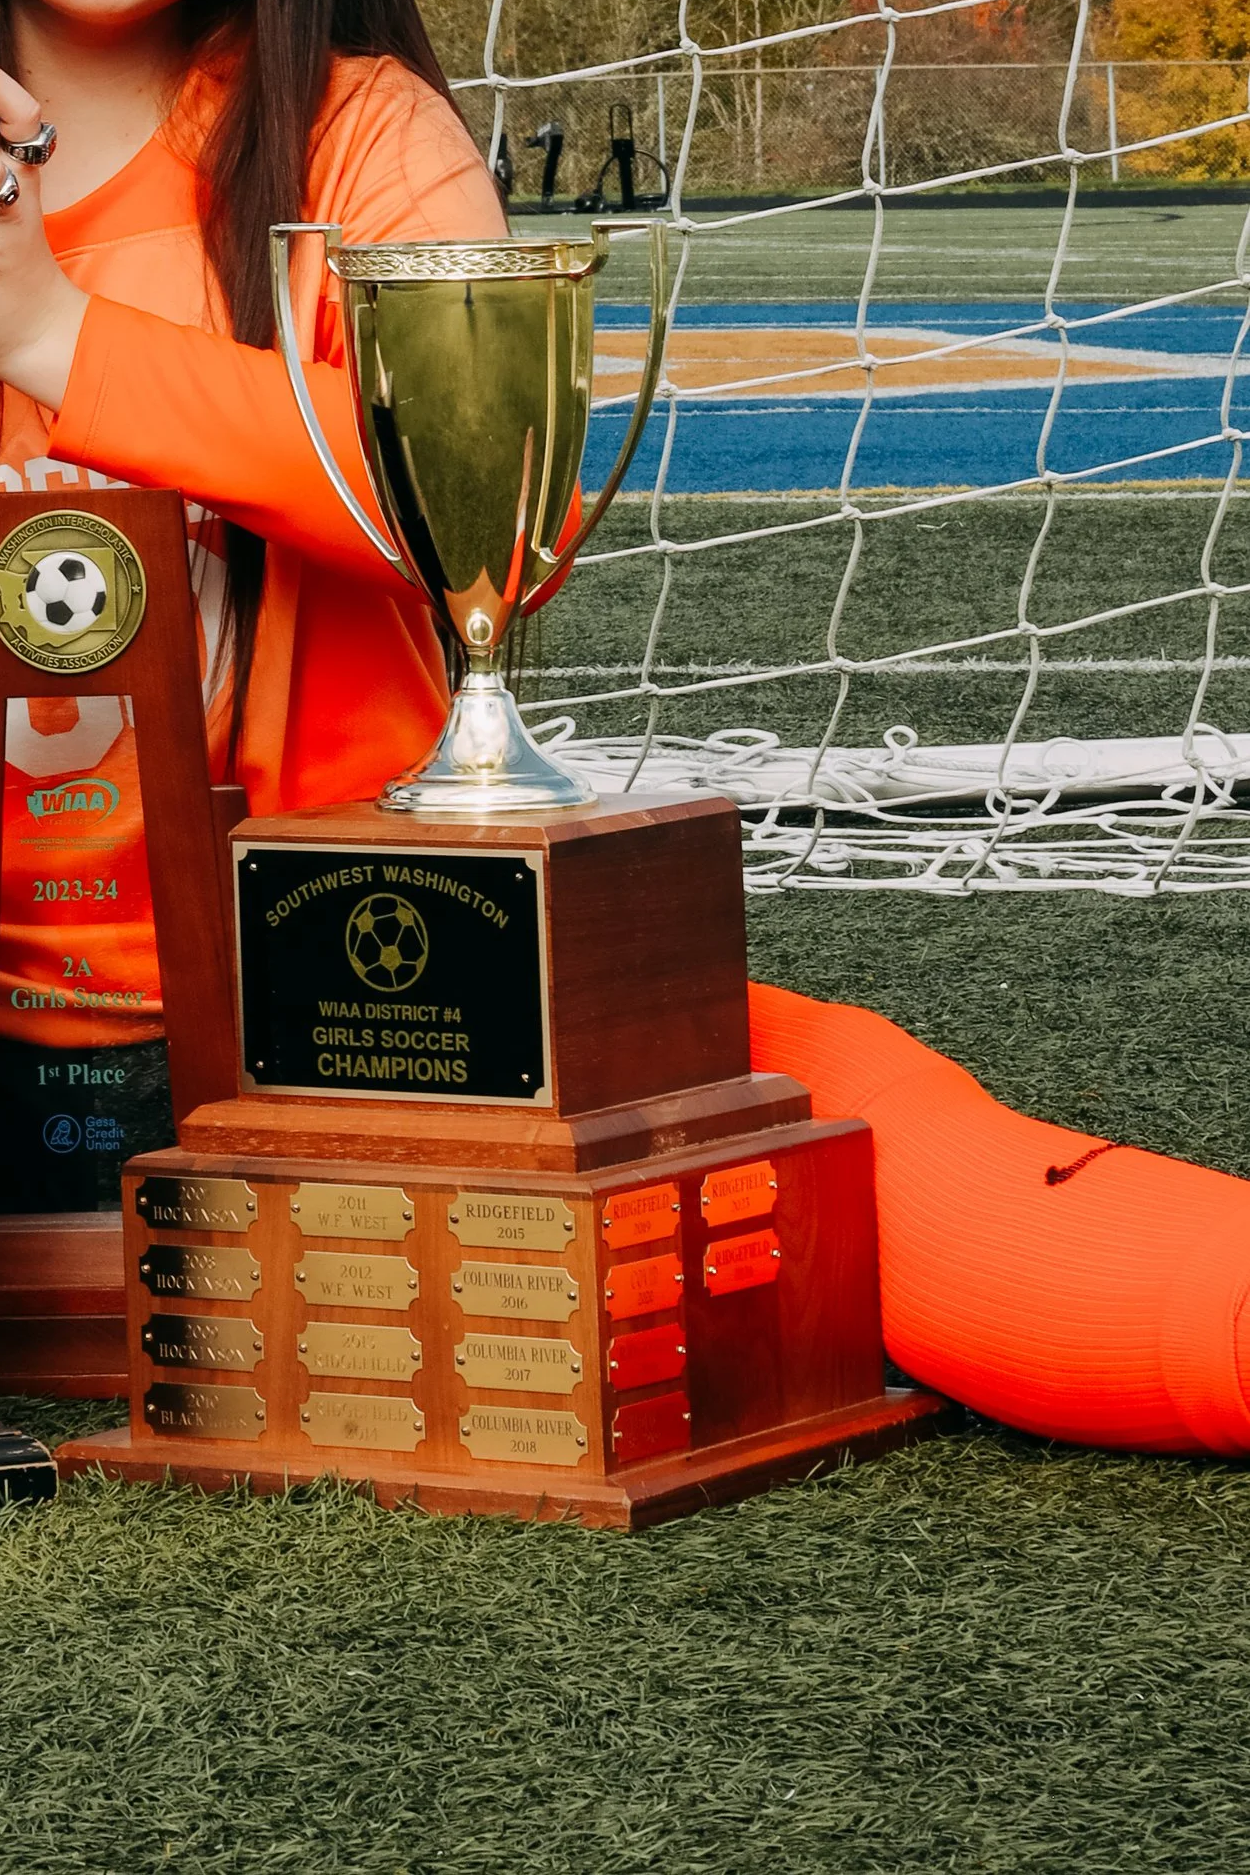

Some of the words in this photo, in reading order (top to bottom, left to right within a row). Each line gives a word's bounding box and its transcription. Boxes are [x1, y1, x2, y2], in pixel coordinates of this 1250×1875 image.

[53, 516, 134, 564] INTERSCHOLASTIC
[10, 637, 60, 669] ACTIVITIES
[61, 635, 124, 669] ASSOCIATION
[41, 792, 105, 812] WIAA
[33, 879, 119, 902] 2023-24
[265, 865, 375, 928] SOUTHWEST
[382, 865, 510, 929] WASHINGTON
[62, 956, 93, 977] 2A
[10, 988, 67, 1010] Girls
[74, 987, 147, 1008] Soccer
[318, 1001, 362, 1018] WIAA
[365, 1003, 439, 1022] DISTRICT
[443, 1006, 461, 1023] #4
[312, 1027, 375, 1047] GIRLS
[380, 1029, 470, 1052] SOCCER
[37, 1065, 60, 1085] 1st
[68, 1064, 126, 1085] Place
[317, 1052, 468, 1083] CHAMPIONS
[85, 1116, 116, 1126] Gesa
[85, 1127, 125, 1139] Credit
[86, 1139, 120, 1150] Union
[712, 1172, 767, 1199] RIDGEFIELD
[337, 1195, 366, 1210] 2011
[613, 1194, 669, 1221] RIDGEFIELD
[153, 1206, 239, 1223] HOCKINSON
[350, 1215, 388, 1230] WEST
[466, 1204, 555, 1222] RIDGEFIELD
[497, 1227, 525, 1240] 2015
[183, 1254, 216, 1269] 2008
[715, 1239, 770, 1267] RIDGEFIELD
[340, 1265, 372, 1279] 2012
[463, 1271, 524, 1290] COLUMBIA
[527, 1275, 564, 1292] RIVER
[157, 1274, 242, 1292] HOCKINSON
[353, 1284, 394, 1299] WEST
[501, 1296, 528, 1309] 2016
[159, 1343, 245, 1362] HOCKINSON
[466, 1343, 526, 1361] COLUMBIA
[531, 1347, 567, 1364] RIVER
[504, 1368, 531, 1381] 2017
[161, 1411, 204, 1426] BLACK
[472, 1415, 531, 1434] COLUMBIA
[536, 1418, 572, 1436] RIVER
[510, 1440, 537, 1453] 2018
